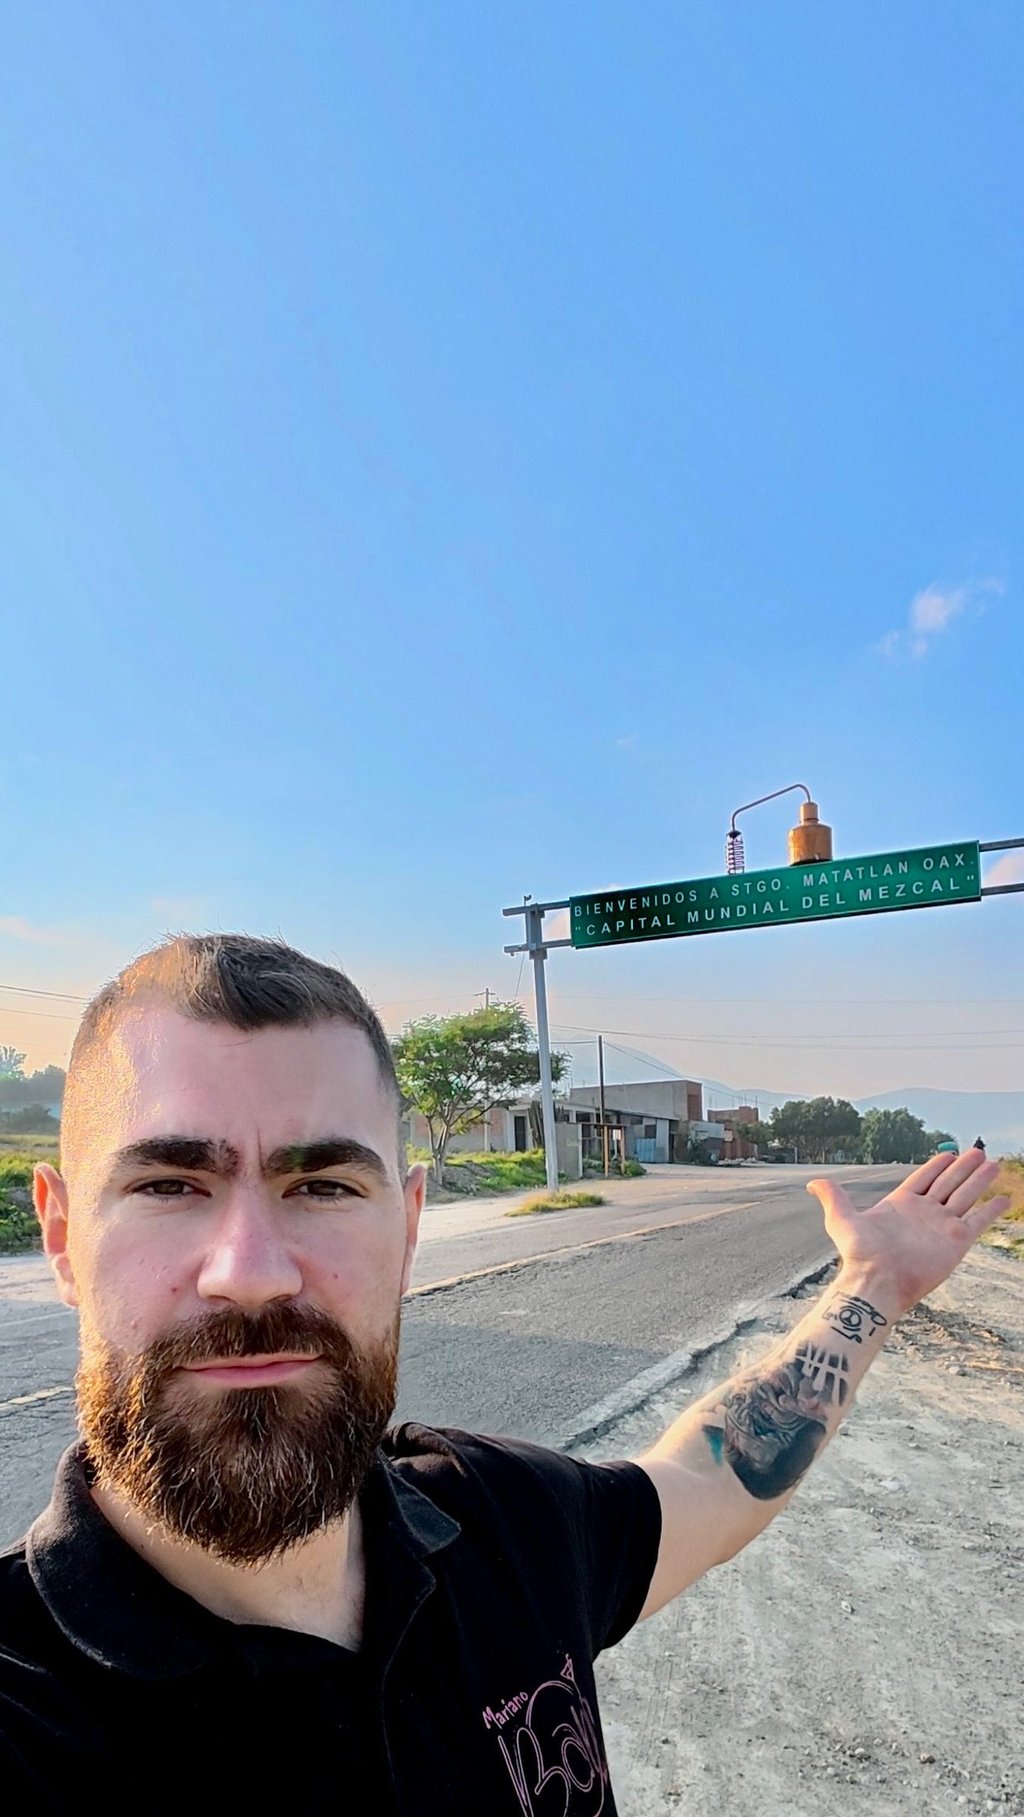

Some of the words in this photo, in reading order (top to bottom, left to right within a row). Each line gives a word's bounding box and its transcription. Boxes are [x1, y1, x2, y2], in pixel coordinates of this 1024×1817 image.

[574, 889, 697, 917] BIENVENIDOS
[709, 887, 719, 899] A
[732, 878, 790, 896] STGO.
[803, 861, 908, 887] MATATLAN
[575, 914, 675, 936] "CAPITAL
[687, 899, 789, 924] MUNDIAL
[802, 892, 846, 909] DEL
[859, 875, 975, 902] MEZCAL"
[482, 1692, 529, 1729] Mariano
